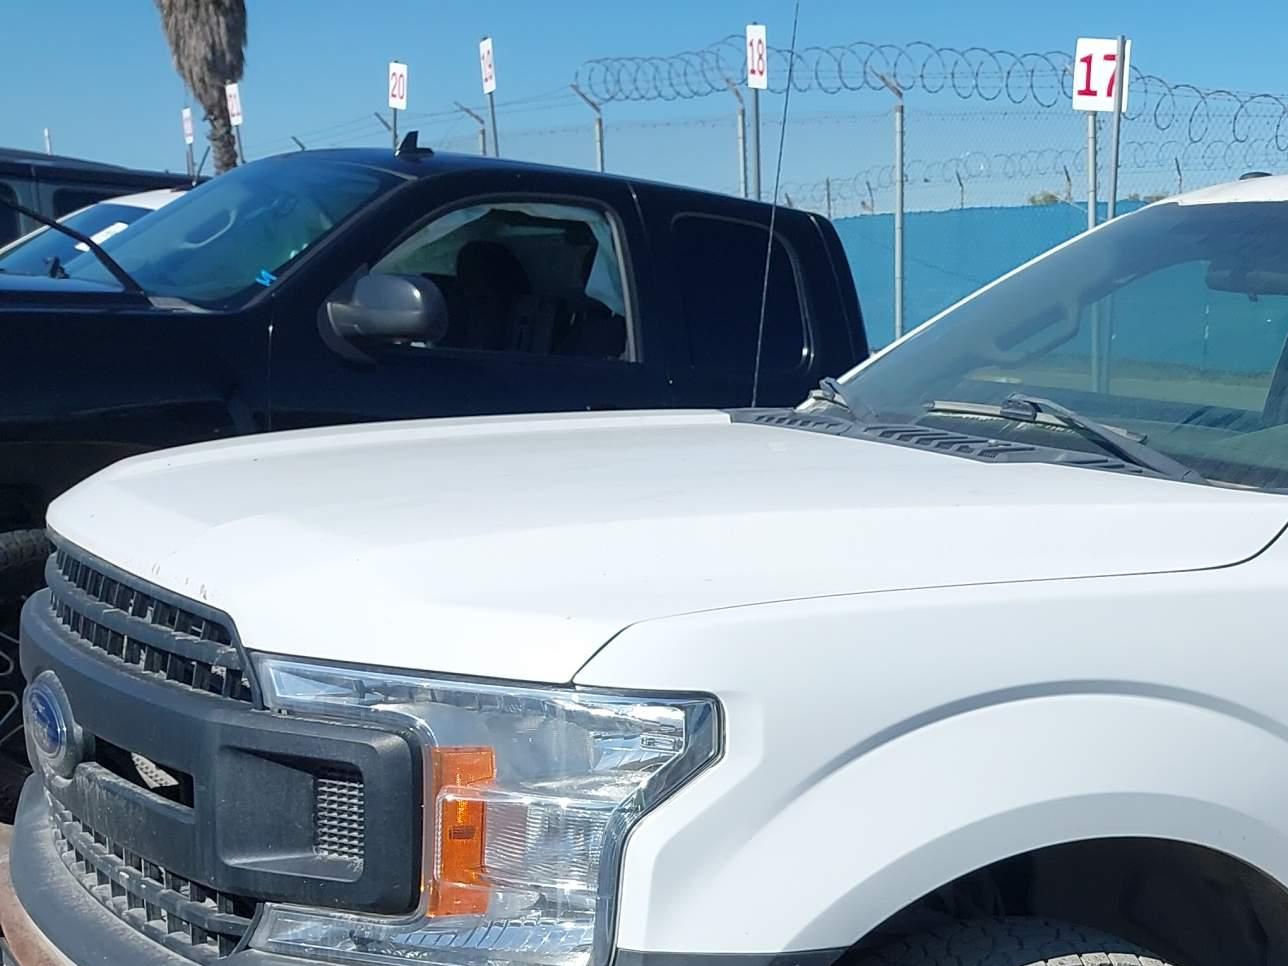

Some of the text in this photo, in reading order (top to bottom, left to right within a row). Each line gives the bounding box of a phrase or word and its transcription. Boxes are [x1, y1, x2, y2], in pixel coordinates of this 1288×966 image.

[749, 38, 765, 77] 18
[1077, 53, 1118, 98] 17
[390, 71, 405, 100] 20
